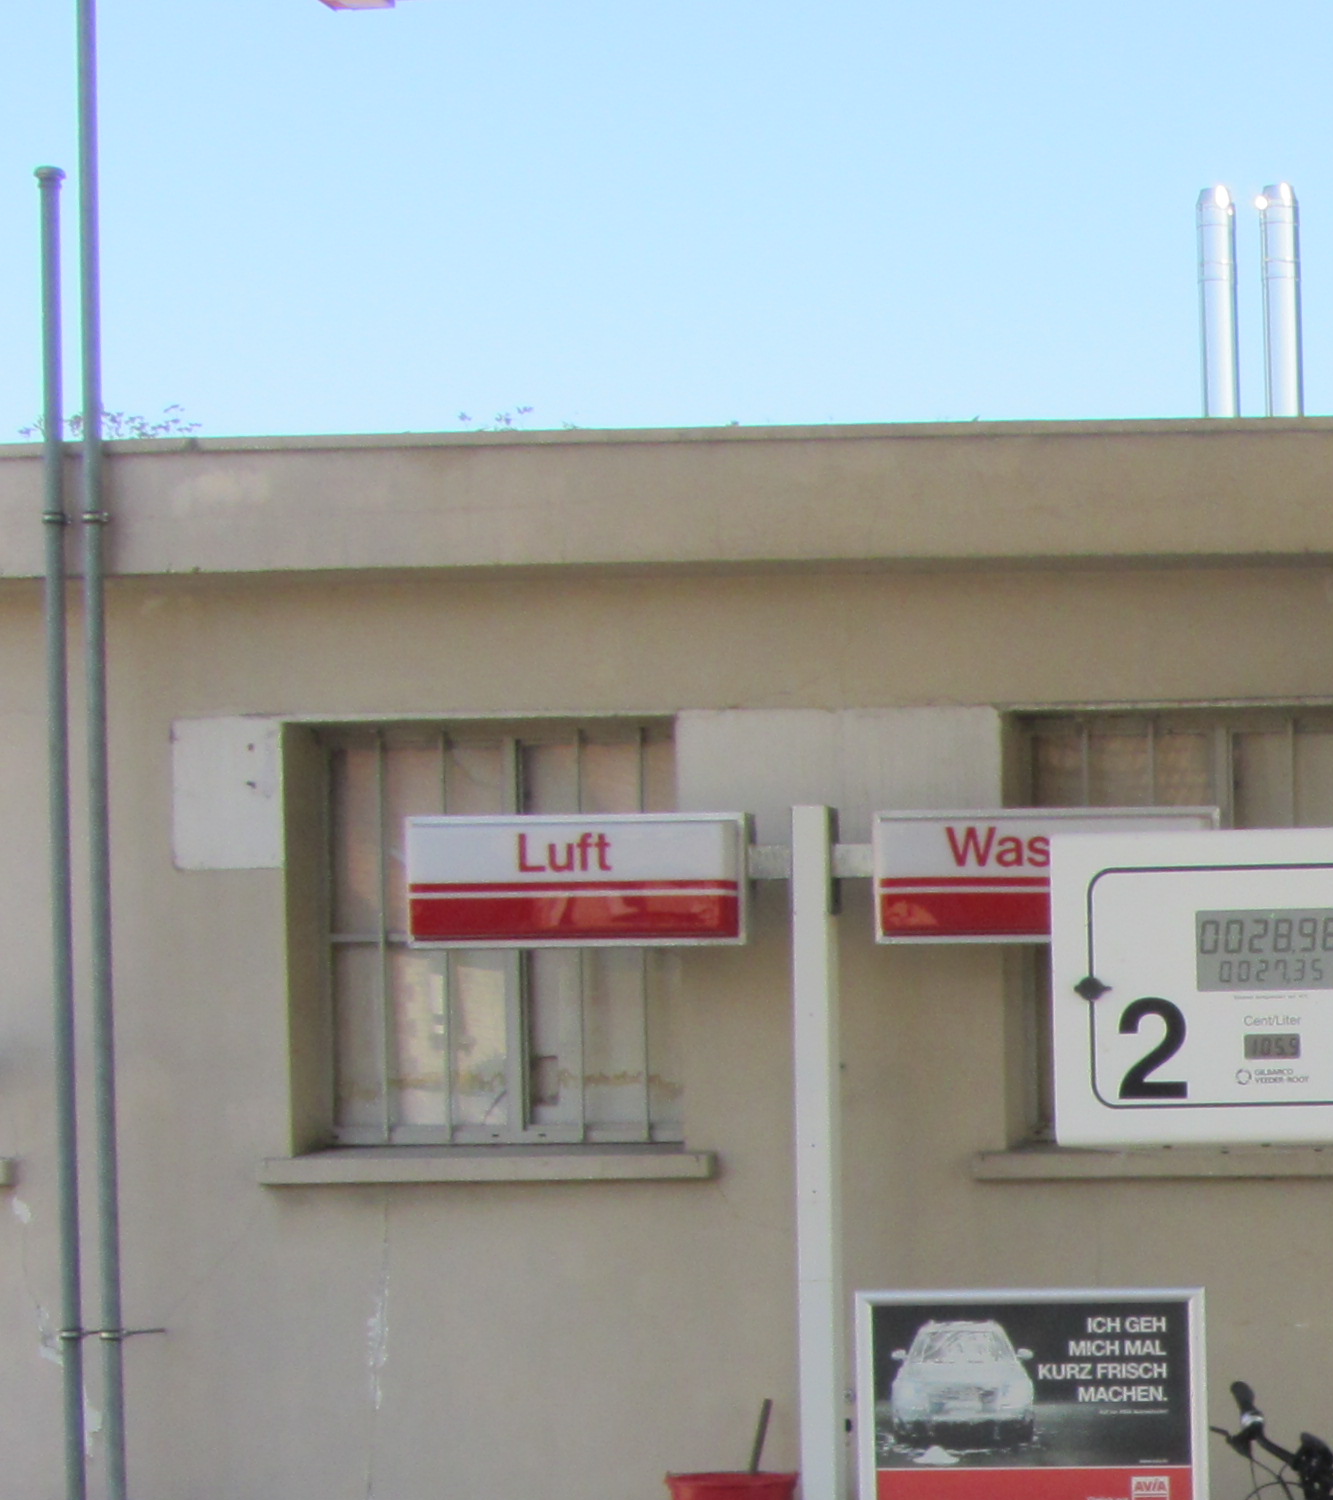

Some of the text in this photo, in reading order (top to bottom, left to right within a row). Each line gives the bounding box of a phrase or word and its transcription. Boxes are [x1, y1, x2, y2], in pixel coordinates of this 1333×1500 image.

[517, 832, 612, 873] Luft
[946, 826, 1050, 868] Was
[1243, 1015, 1301, 1027] Cent/Liter
[1118, 996, 1188, 1100] 2
[1087, 1316, 1166, 1333] ICH GEH
[1069, 1339, 1166, 1356] MICH MAL
[1038, 1363, 1167, 1380] KURZ FRISCH
[1078, 1386, 1168, 1402] MACHEN.
[1134, 1479, 1167, 1492] AVIA
